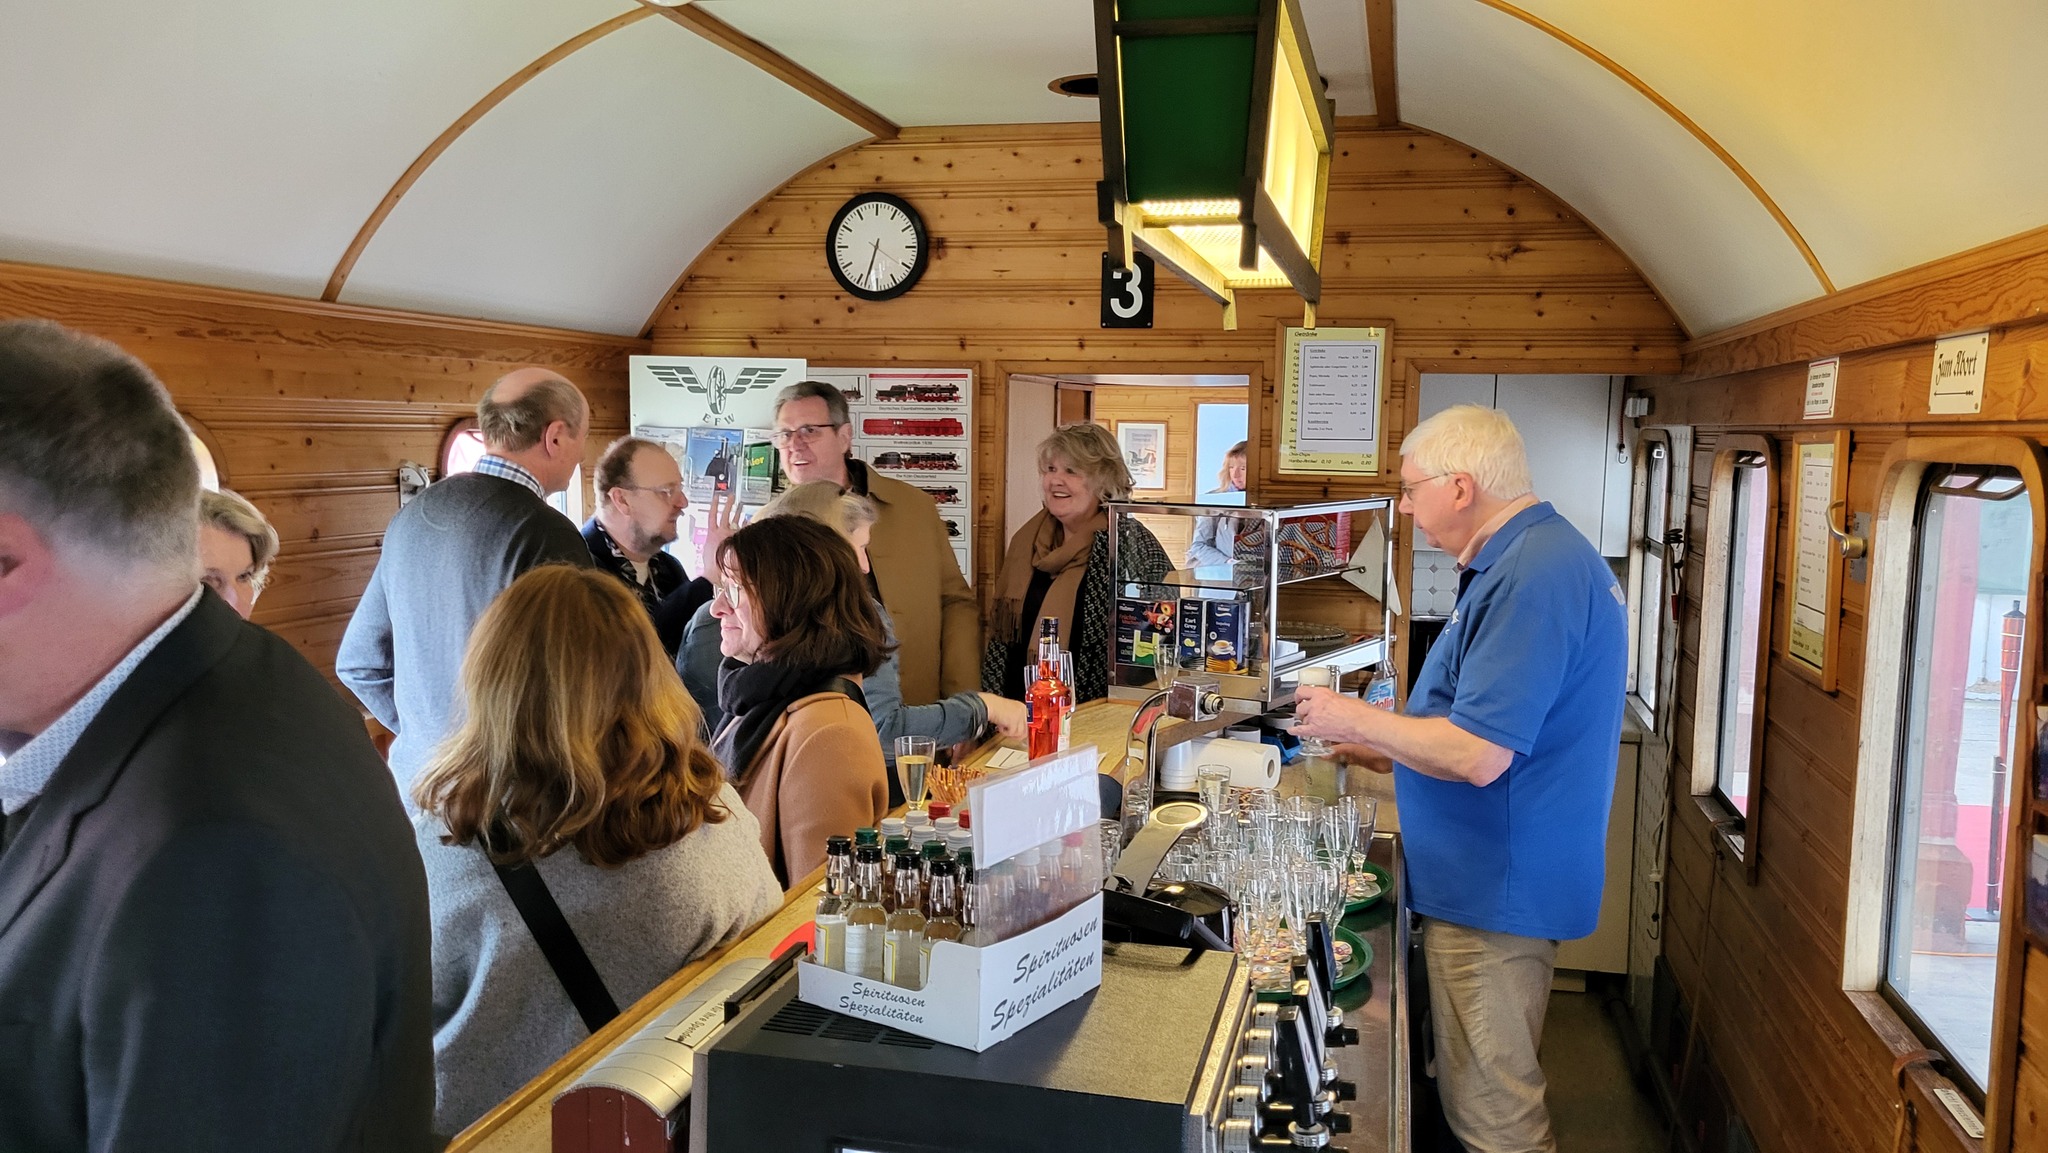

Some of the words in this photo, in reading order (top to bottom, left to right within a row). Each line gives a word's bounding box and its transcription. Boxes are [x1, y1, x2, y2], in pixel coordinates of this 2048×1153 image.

[1111, 262, 1143, 318] 3
[1935, 353, 1954, 386] Zum
[1953, 350, 1978, 377] Abort
[1183, 623, 1197, 631] Grey
[1012, 917, 1098, 984] Spirituosen
[852, 982, 926, 1007] Spirituosen
[990, 951, 1095, 1031] Spezialitäten
[839, 996, 924, 1024] Spezialitäten
